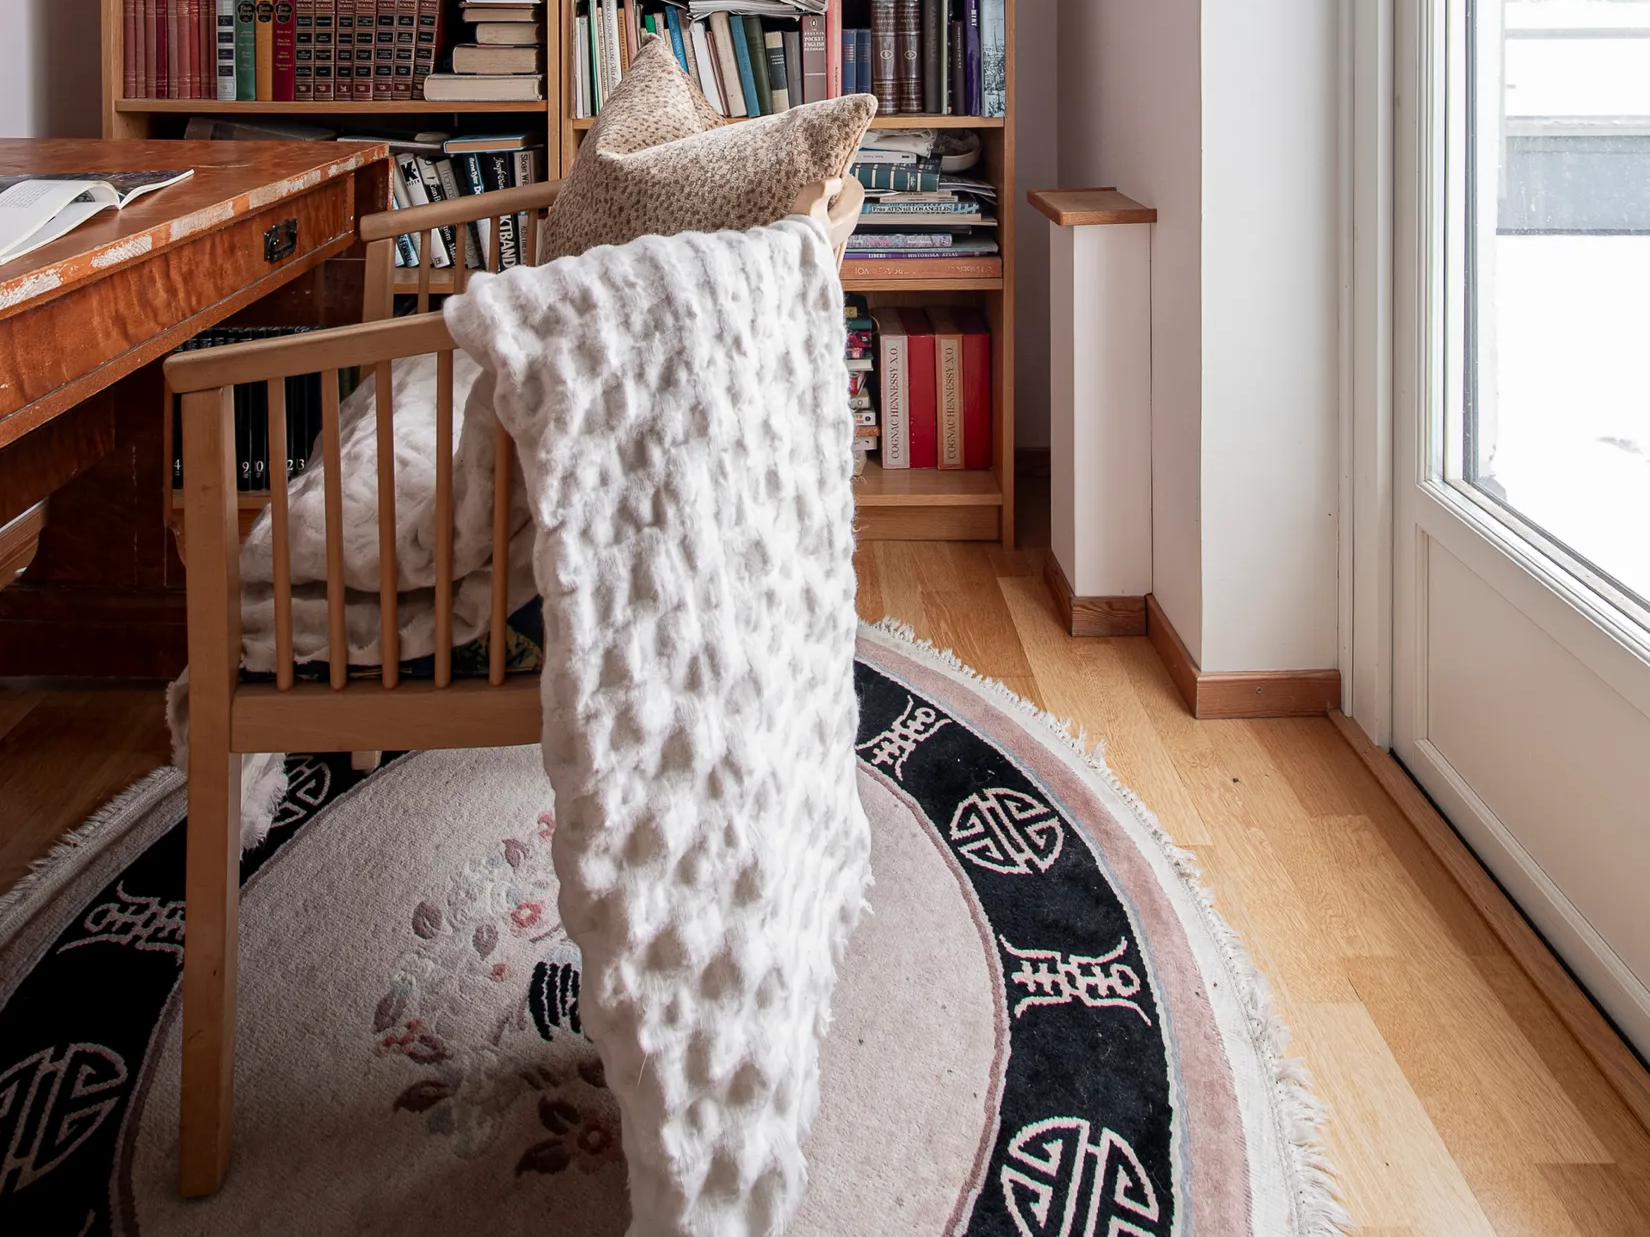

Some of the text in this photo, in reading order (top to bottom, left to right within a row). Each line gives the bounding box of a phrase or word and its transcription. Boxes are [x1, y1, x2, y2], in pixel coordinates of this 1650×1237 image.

[520, 153, 529, 173] Sloan
[889, 346, 900, 460] COGNAC HENNESSY X.O.
[945, 366, 956, 460] COGNAC HENNESSY
[174, 459, 181, 469] 4
[242, 461, 250, 472] 9
